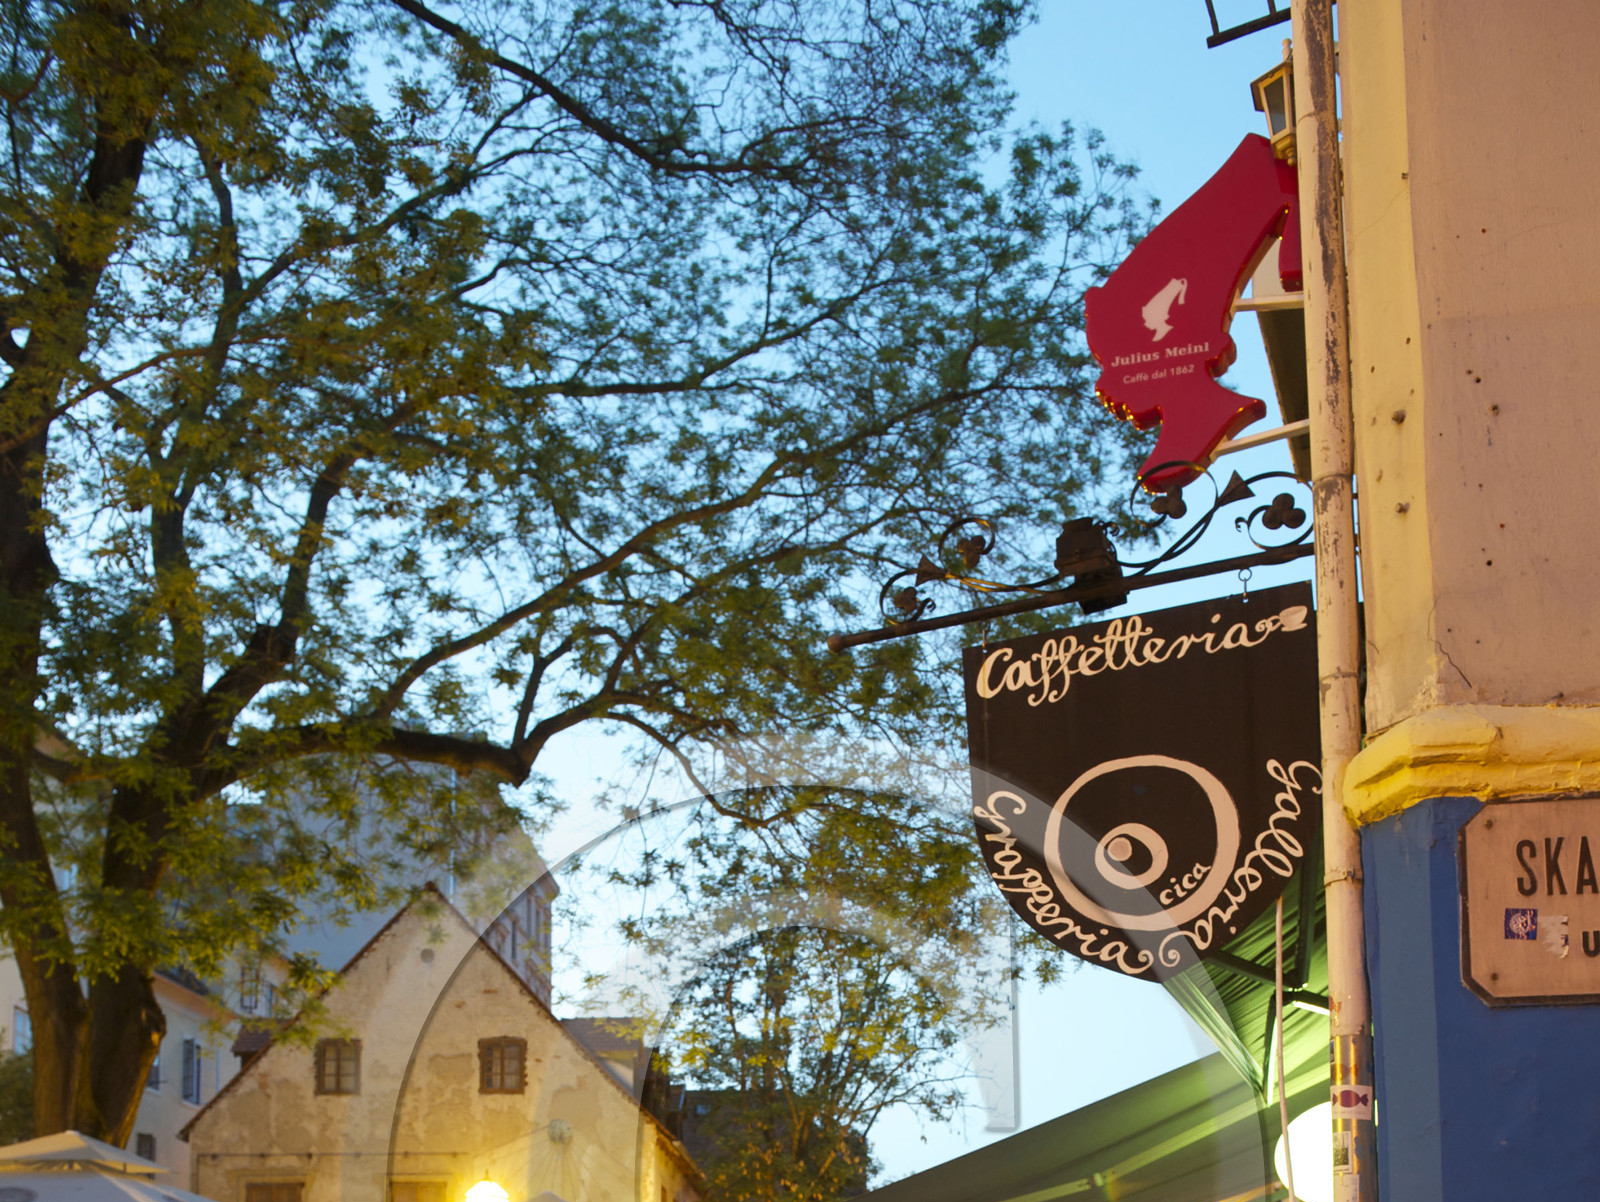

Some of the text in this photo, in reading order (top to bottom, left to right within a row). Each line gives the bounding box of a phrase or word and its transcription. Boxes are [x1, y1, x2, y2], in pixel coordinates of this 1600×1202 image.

[1111, 342, 1210, 367] Julius Meinl
[1151, 369, 1167, 380] dal
[1170, 365, 1195, 377] 1862
[976, 613, 1268, 706] Caffetteria
[974, 791, 1154, 974] Grapperia
[1159, 759, 1323, 967] Galleria
[1159, 862, 1212, 905] cica
[1515, 836, 1600, 896] SKA
